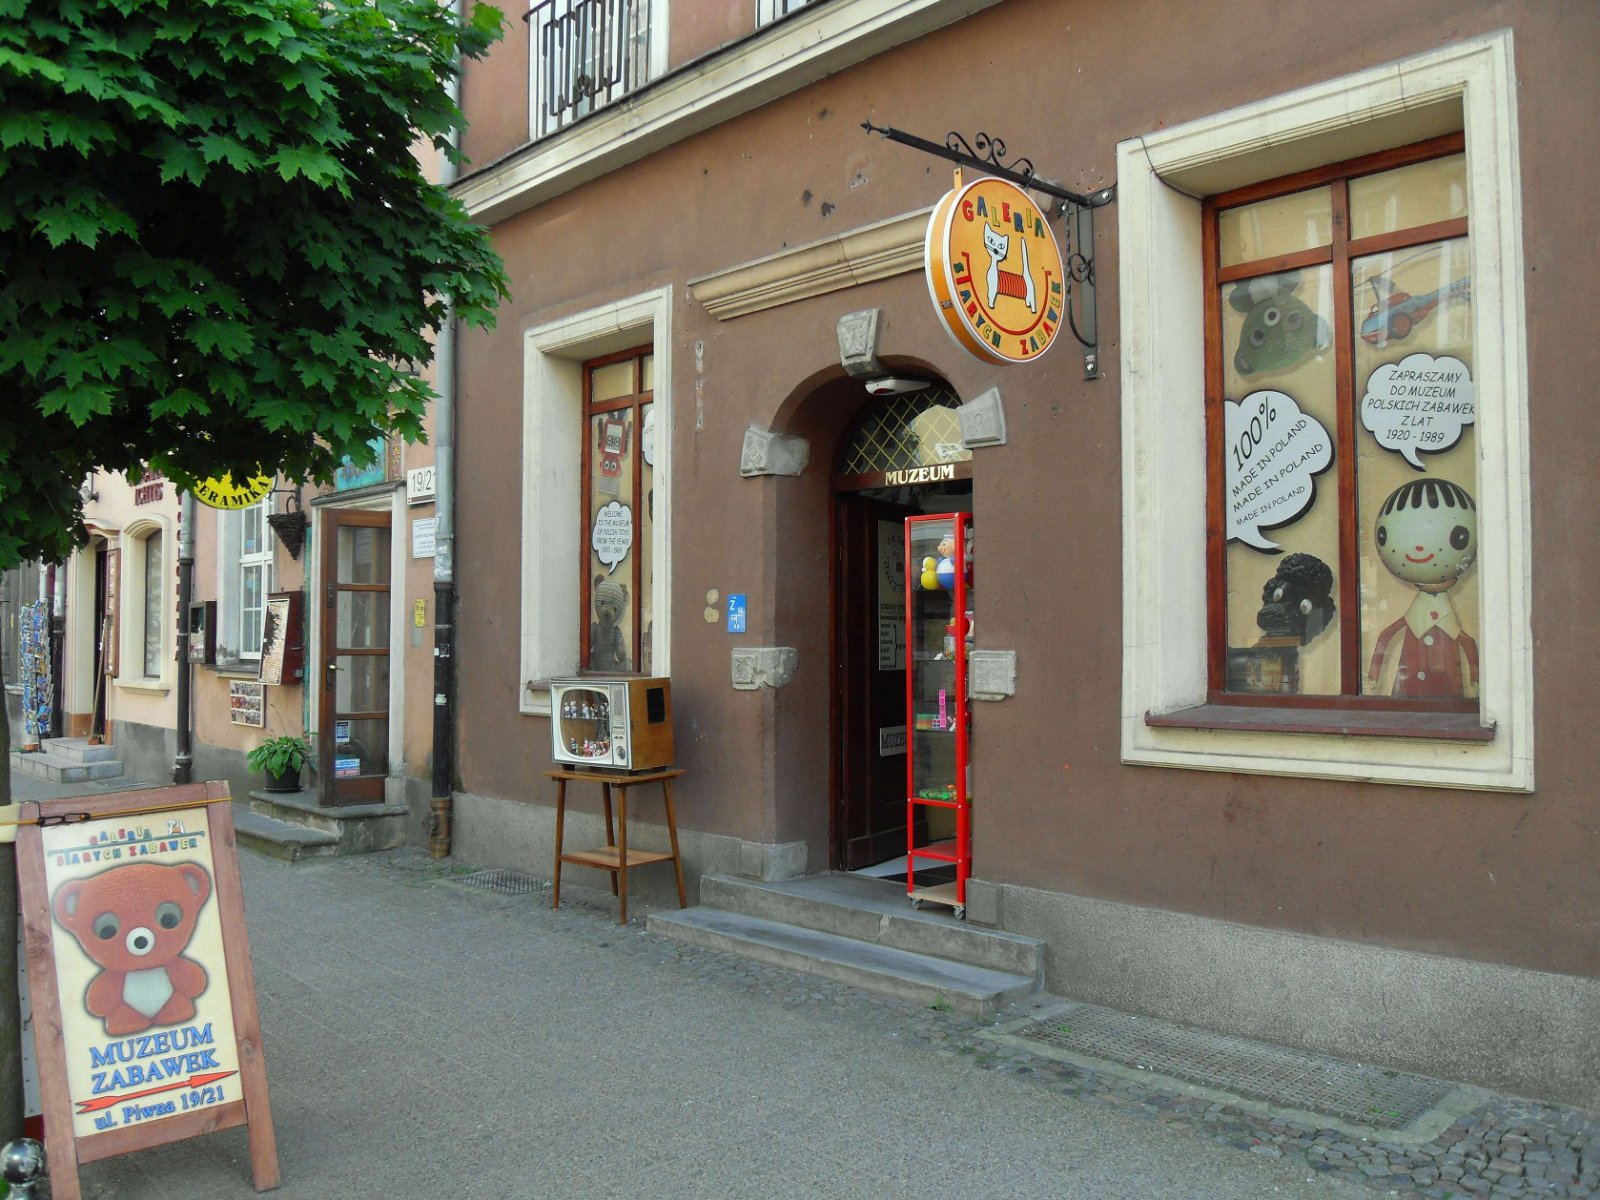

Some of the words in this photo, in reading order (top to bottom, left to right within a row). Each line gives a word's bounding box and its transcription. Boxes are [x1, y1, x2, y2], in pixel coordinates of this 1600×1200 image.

[962, 195, 1045, 238] GALERIA
[953, 262, 1001, 348] STARYCH
[1019, 281, 1061, 355] ZABAWEK
[1389, 370, 1462, 383] ZAPRASZAMY
[1390, 385, 1406, 396] DO
[1408, 386, 1456, 398] MUZEUM
[1367, 398, 1420, 411] POLSKICH
[1422, 402, 1475, 415] ZABAWEK
[1401, 416, 1410, 426] Z
[1410, 416, 1434, 427] LAT
[1233, 396, 1276, 471] 100%
[1386, 429, 1410, 440] 1920
[1420, 431, 1444, 443] 1989
[885, 464, 955, 485] MUZEUM
[1232, 467, 1258, 497] MADE
[1256, 454, 1272, 471] IN
[1270, 419, 1307, 458] POLAND
[197, 481, 269, 507] ERAMIKA
[1233, 487, 1263, 512] MADE
[1265, 475, 1279, 489] IN
[1280, 443, 1323, 478] POLAND
[1236, 508, 1259, 526] MADE
[1260, 502, 1272, 514] IN
[1272, 486, 1305, 507] POLAND
[57, 847, 121, 867] STARYCH
[129, 837, 197, 857] ZABAWEK
[89, 826, 153, 845] GALERIA
[89, 1023, 214, 1068] MUZEUM
[91, 1048, 220, 1094] ZABAWEK
[94, 1111, 118, 1130] ul.
[122, 1100, 176, 1124] Piwna
[181, 1085, 225, 1110] 19/21
